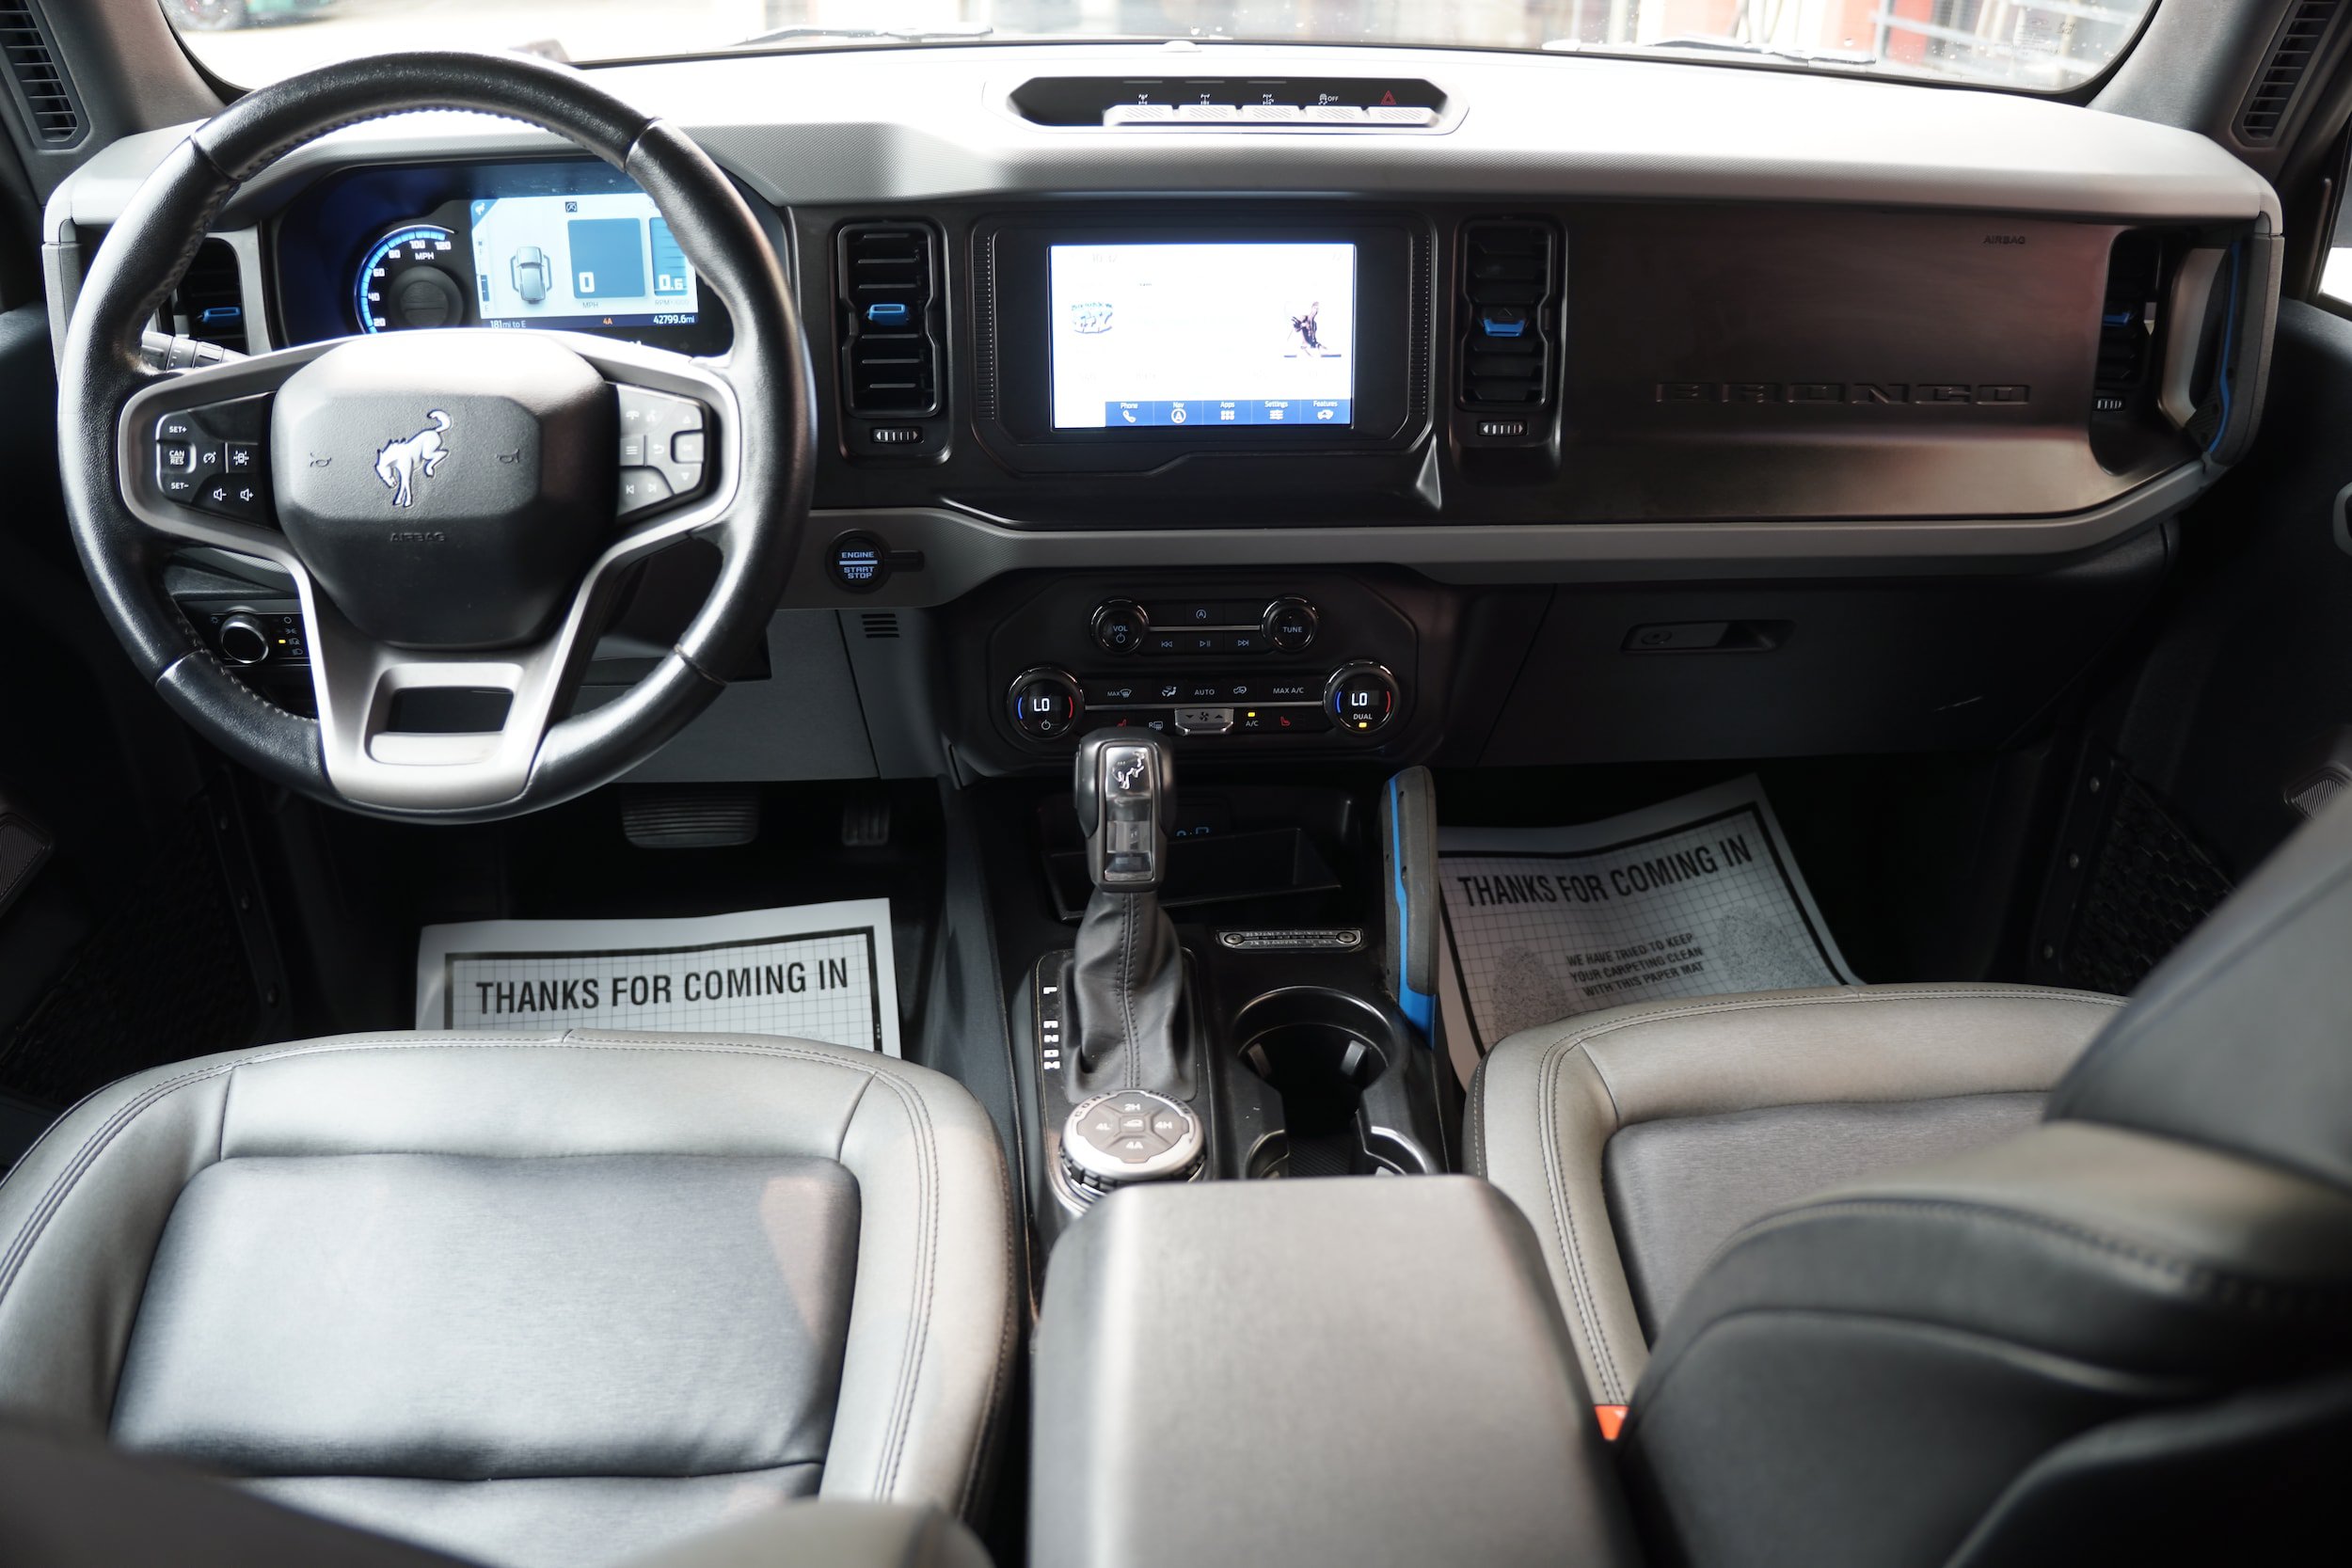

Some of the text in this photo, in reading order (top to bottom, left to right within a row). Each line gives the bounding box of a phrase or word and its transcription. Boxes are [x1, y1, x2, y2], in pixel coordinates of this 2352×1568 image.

[409, 240, 425, 249] 100
[435, 241, 452, 250] 120
[1983, 235, 2026, 245] AIRBAG
[389, 249, 401, 259] 80
[415, 252, 435, 261] MPH
[373, 268, 385, 277] 60
[579, 272, 595, 293] 0
[659, 275, 683, 291] 0.6
[368, 293, 380, 301] 40
[373, 318, 386, 326] 20
[1656, 381, 2030, 404] BRONCO
[389, 531, 446, 543] AIRBAG
[1033, 698, 1050, 711] LO
[1351, 692, 1368, 706] LO
[1457, 834, 1753, 907] THANKS FOR COMING IN
[1566, 932, 1693, 967] WE HAVE TRIED TO KEEP
[1569, 946, 1704, 983] YOUR CARPETING CLEAN
[1581, 961, 1705, 997] WITH THIS PAPER MAT
[476, 957, 849, 1015] THANKS FOR COMING IN
[1096, 1122, 1111, 1131] 4L
[1126, 1141, 1143, 1149] 4A
